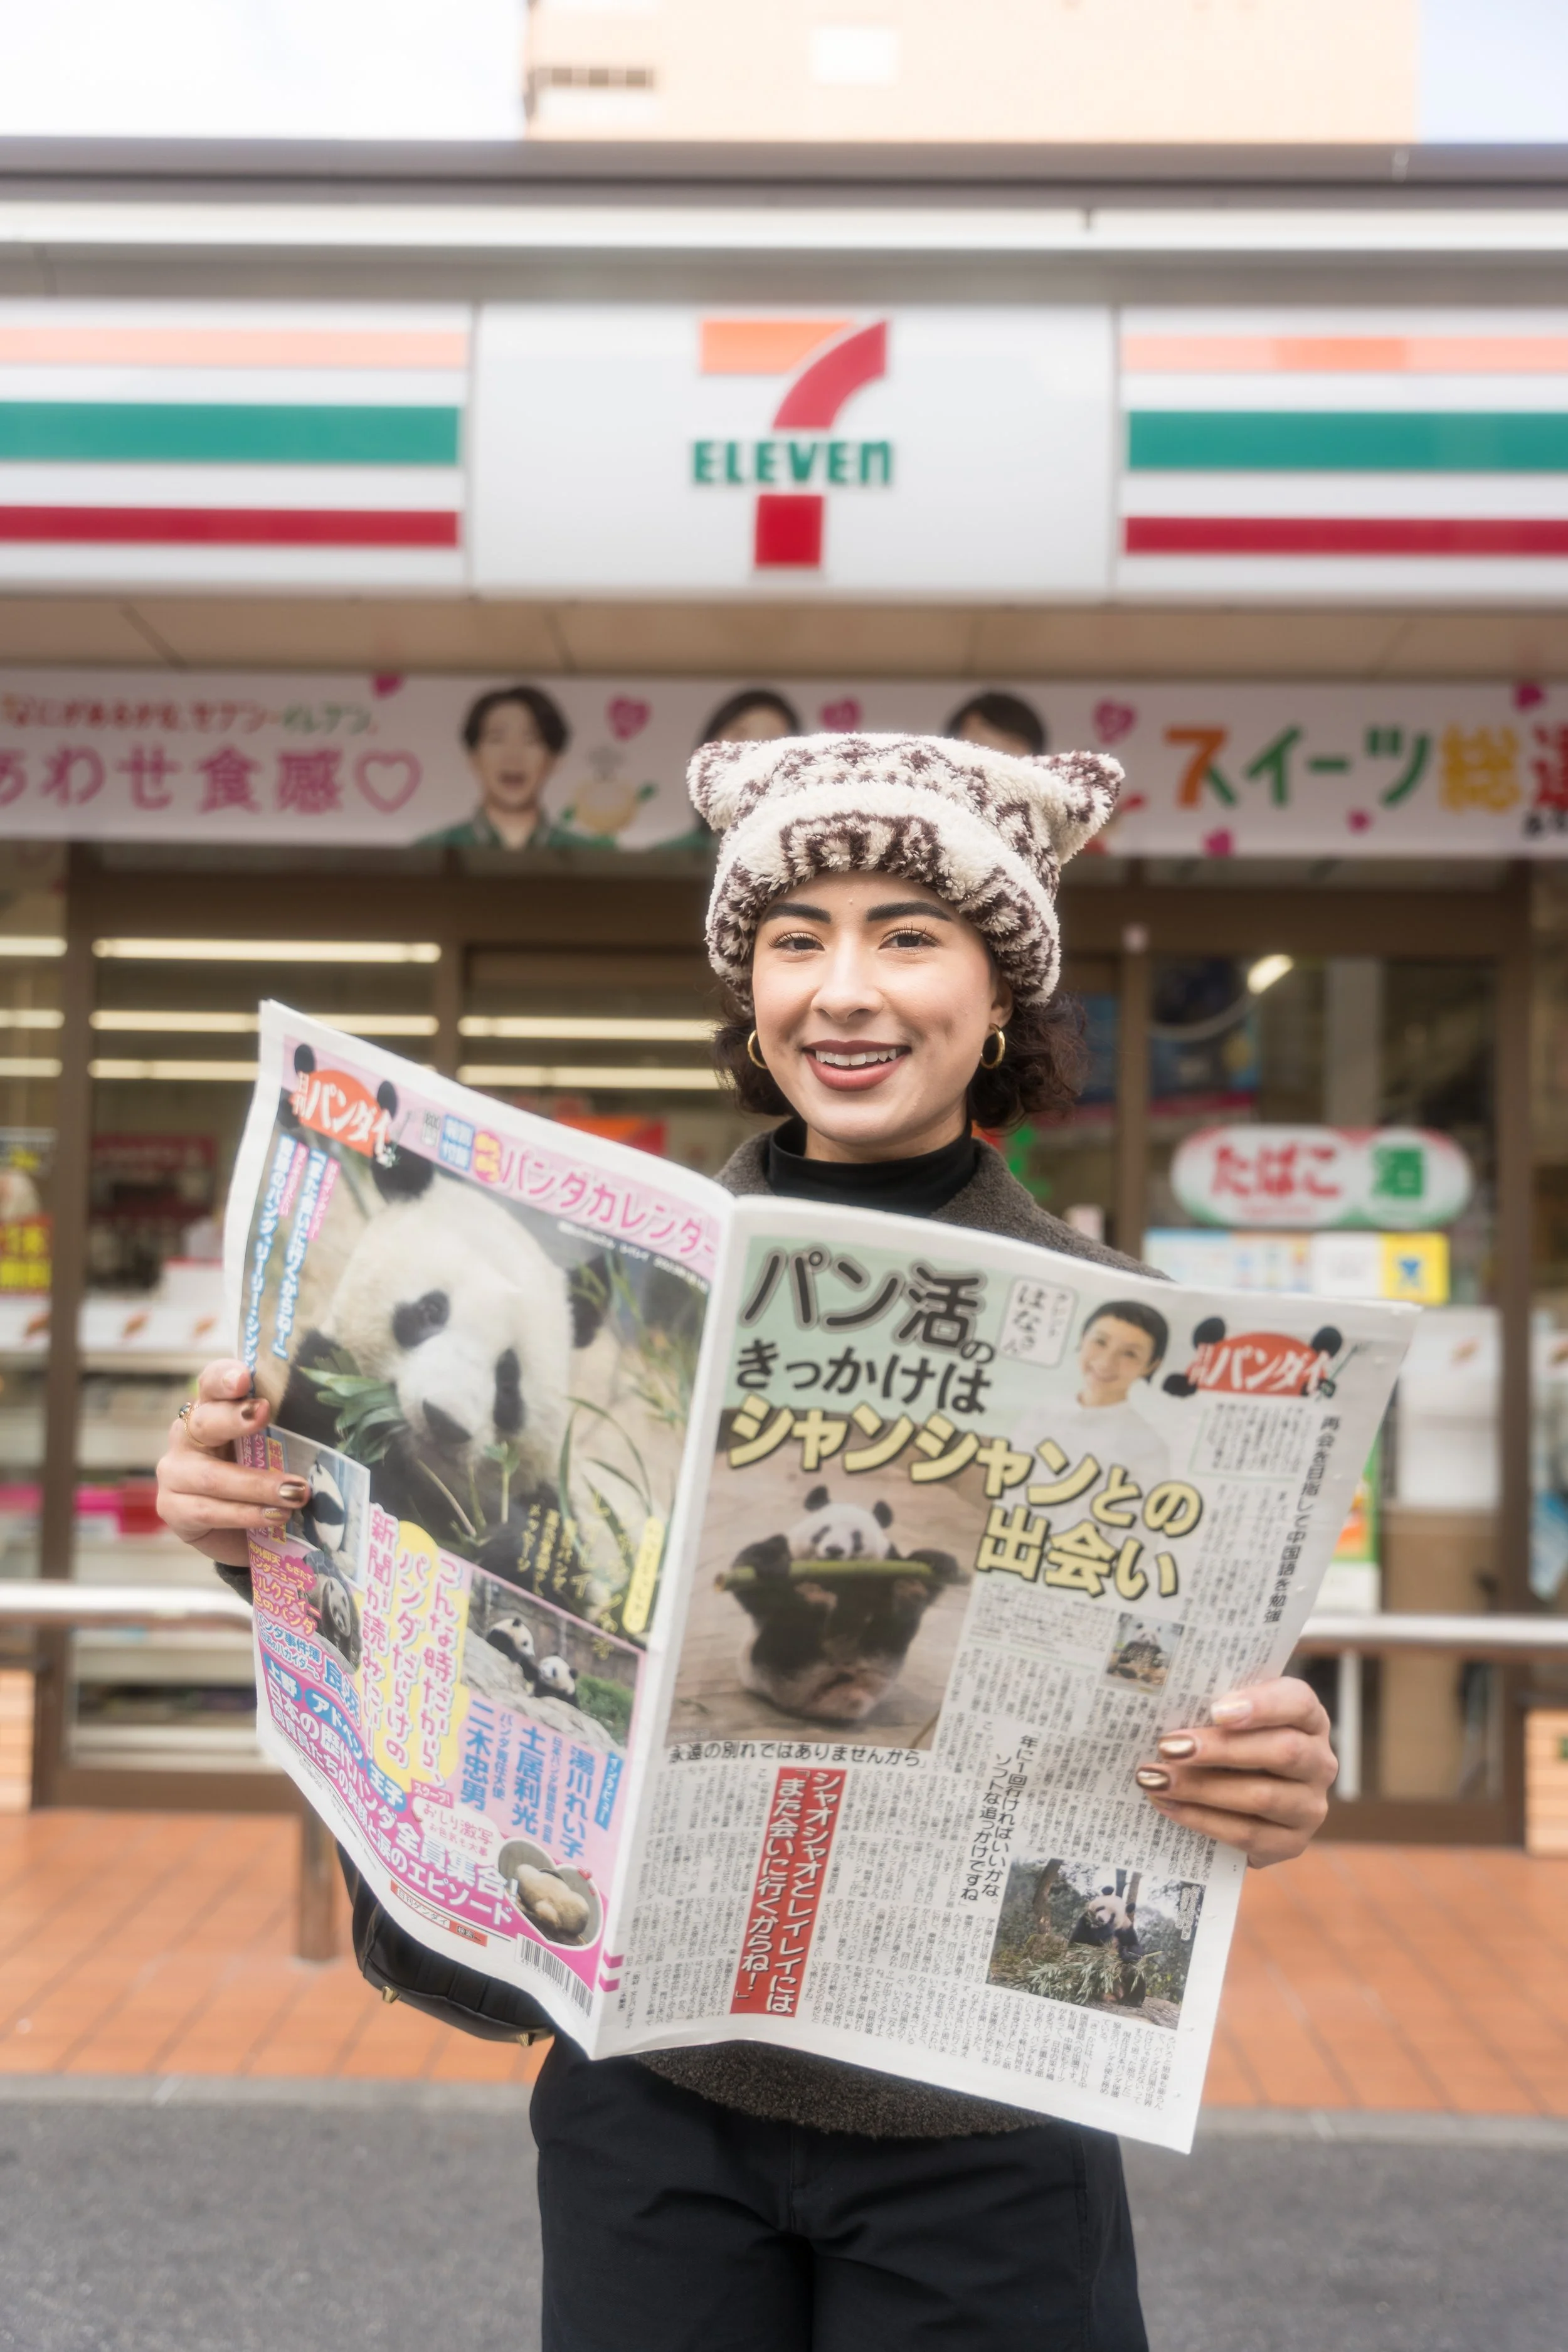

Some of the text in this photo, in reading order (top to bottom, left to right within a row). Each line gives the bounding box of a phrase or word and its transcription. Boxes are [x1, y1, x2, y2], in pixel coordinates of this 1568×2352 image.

[701, 319, 887, 568] 7
[502, 1150, 716, 1255] パンダカレンダー
[1212, 1142, 1340, 1199] たばこ
[738, 1244, 996, 1365] パン活の
[736, 1338, 992, 1414] きっかけは
[728, 1391, 1204, 1538] シャンシャンとの
[1263, 1415, 1342, 1624] 再会を目指して中国語を勉強
[251, 1565, 322, 1619] ミルクティー
[975, 1502, 1180, 1601] 出会い
[386, 1551, 428, 1765] パンダだらけの
[420, 1557, 458, 1784] こんな時だから、
[267, 1660, 297, 1698] 上野
[369, 1762, 405, 1807] 王子
[460, 1700, 495, 1811] 二木忠男
[511, 1725, 547, 1836] 土居利光
[667, 1739, 928, 1767] 永遠の別れではありませんから」
[423, 1803, 494, 1846] おしり激写
[559, 1744, 595, 1858] 湯川れい子
[959, 1752, 1011, 1907] ソフトな追っかけですね」
[396, 1887, 449, 1927] 日刊ゲンダイ
[735, 1769, 812, 2000] 「また会いに行くからね！」
[766, 1771, 841, 2014] シャオシャオとレイレイには
[1099, 2018, 1111, 2042] ている。
